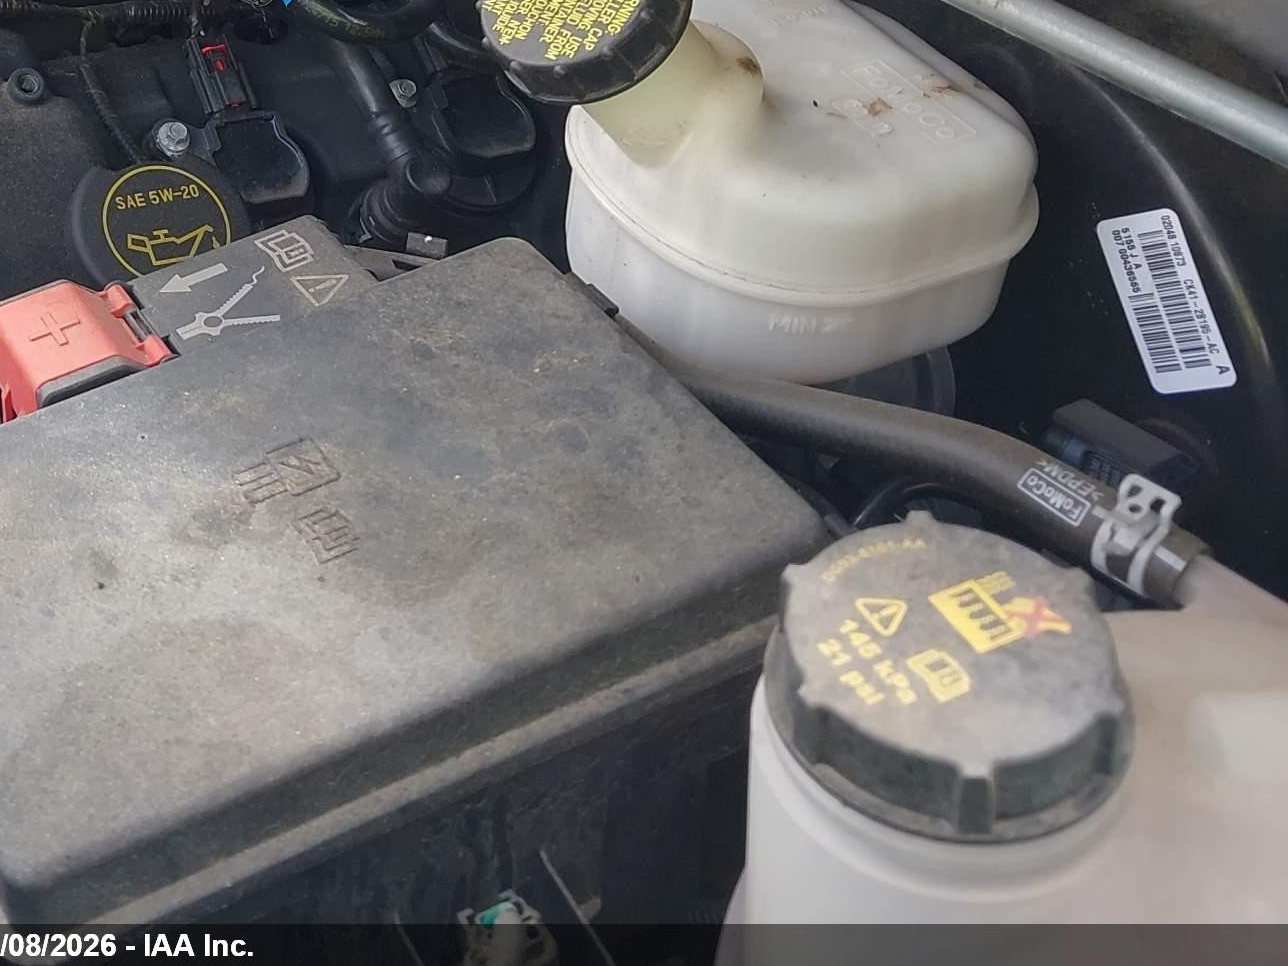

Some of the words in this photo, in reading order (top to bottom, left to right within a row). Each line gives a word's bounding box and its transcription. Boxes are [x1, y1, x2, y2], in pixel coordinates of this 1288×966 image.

[543, 28, 571, 60] FROM
[560, 35, 582, 58] USE
[582, 27, 603, 51] CAP
[853, 65, 954, 138] FoMoCo
[115, 191, 147, 211] SAE
[148, 183, 200, 206] 5W-20
[1110, 229, 1124, 246] 007
[768, 313, 817, 334] MIN
[1215, 364, 1230, 374] A
[1026, 475, 1084, 520] FoMoCo
[816, 638, 853, 666] 21
[839, 671, 886, 706] psi
[873, 659, 918, 706] kPa
